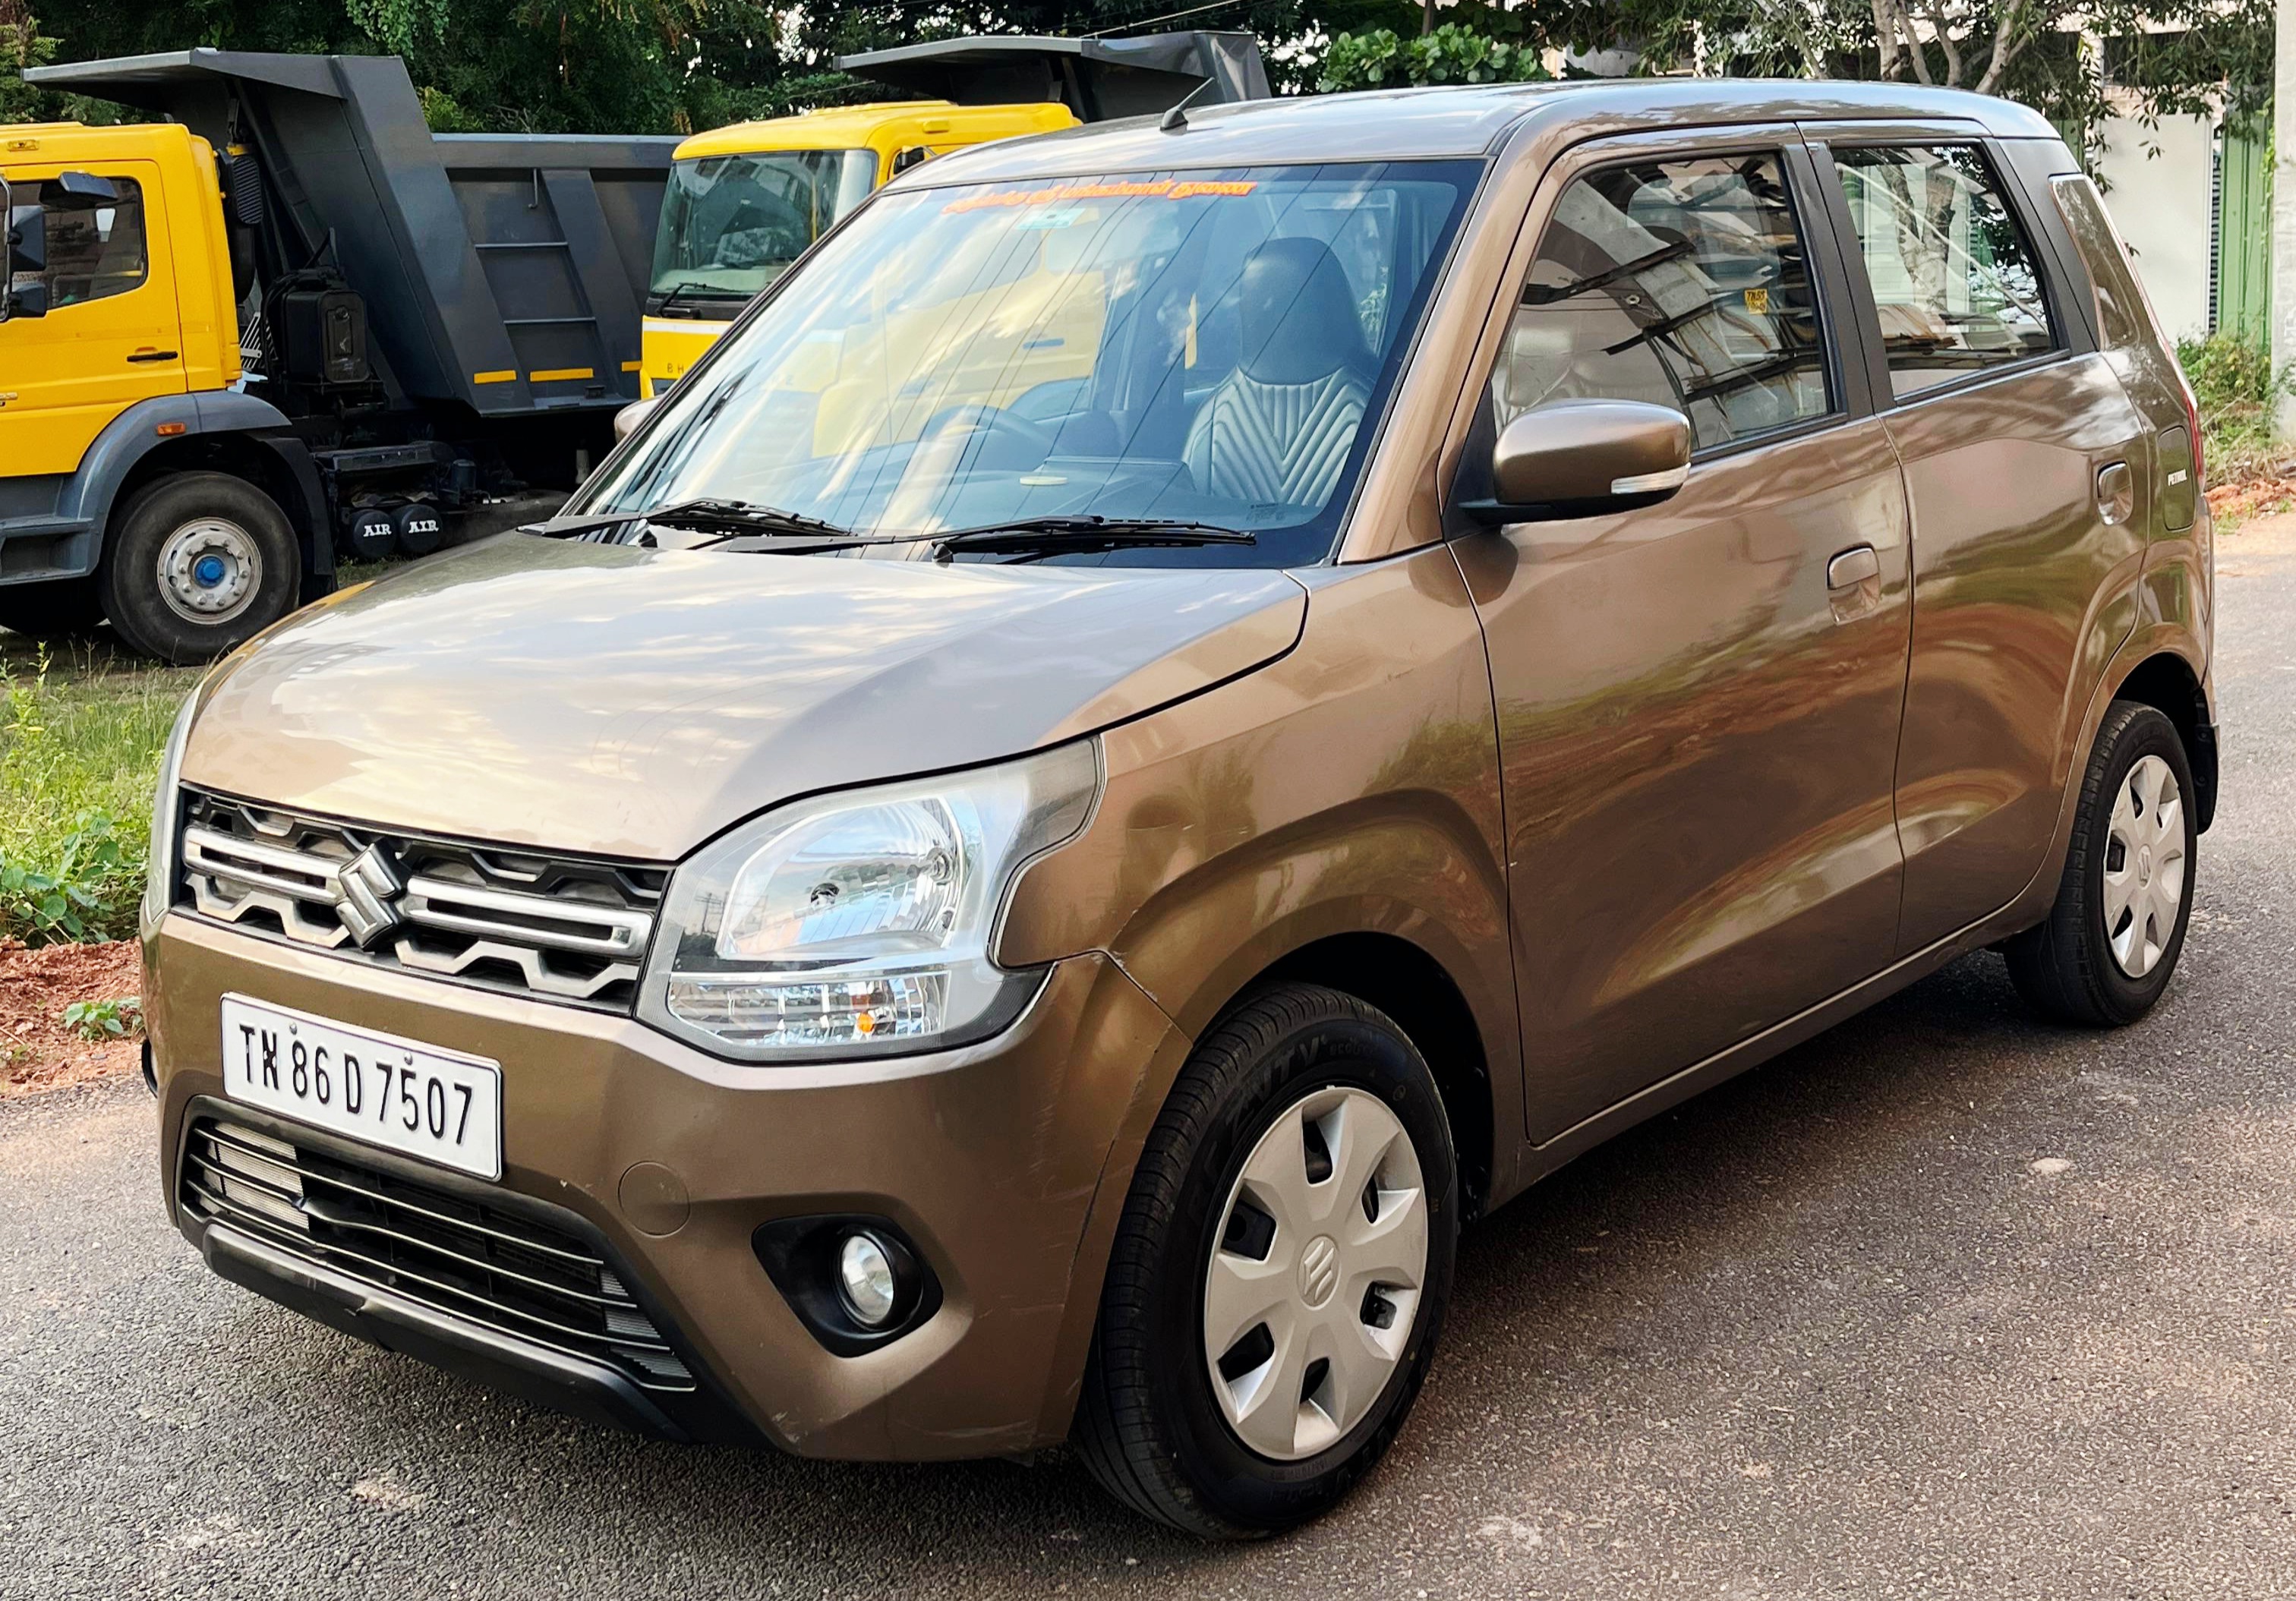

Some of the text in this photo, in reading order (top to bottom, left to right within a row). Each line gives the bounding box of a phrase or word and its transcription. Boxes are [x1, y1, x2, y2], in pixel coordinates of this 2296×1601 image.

[363, 523, 392, 537] AIR
[408, 520, 439, 533] AIR
[239, 1023, 474, 1146] TN 86 D 7507
